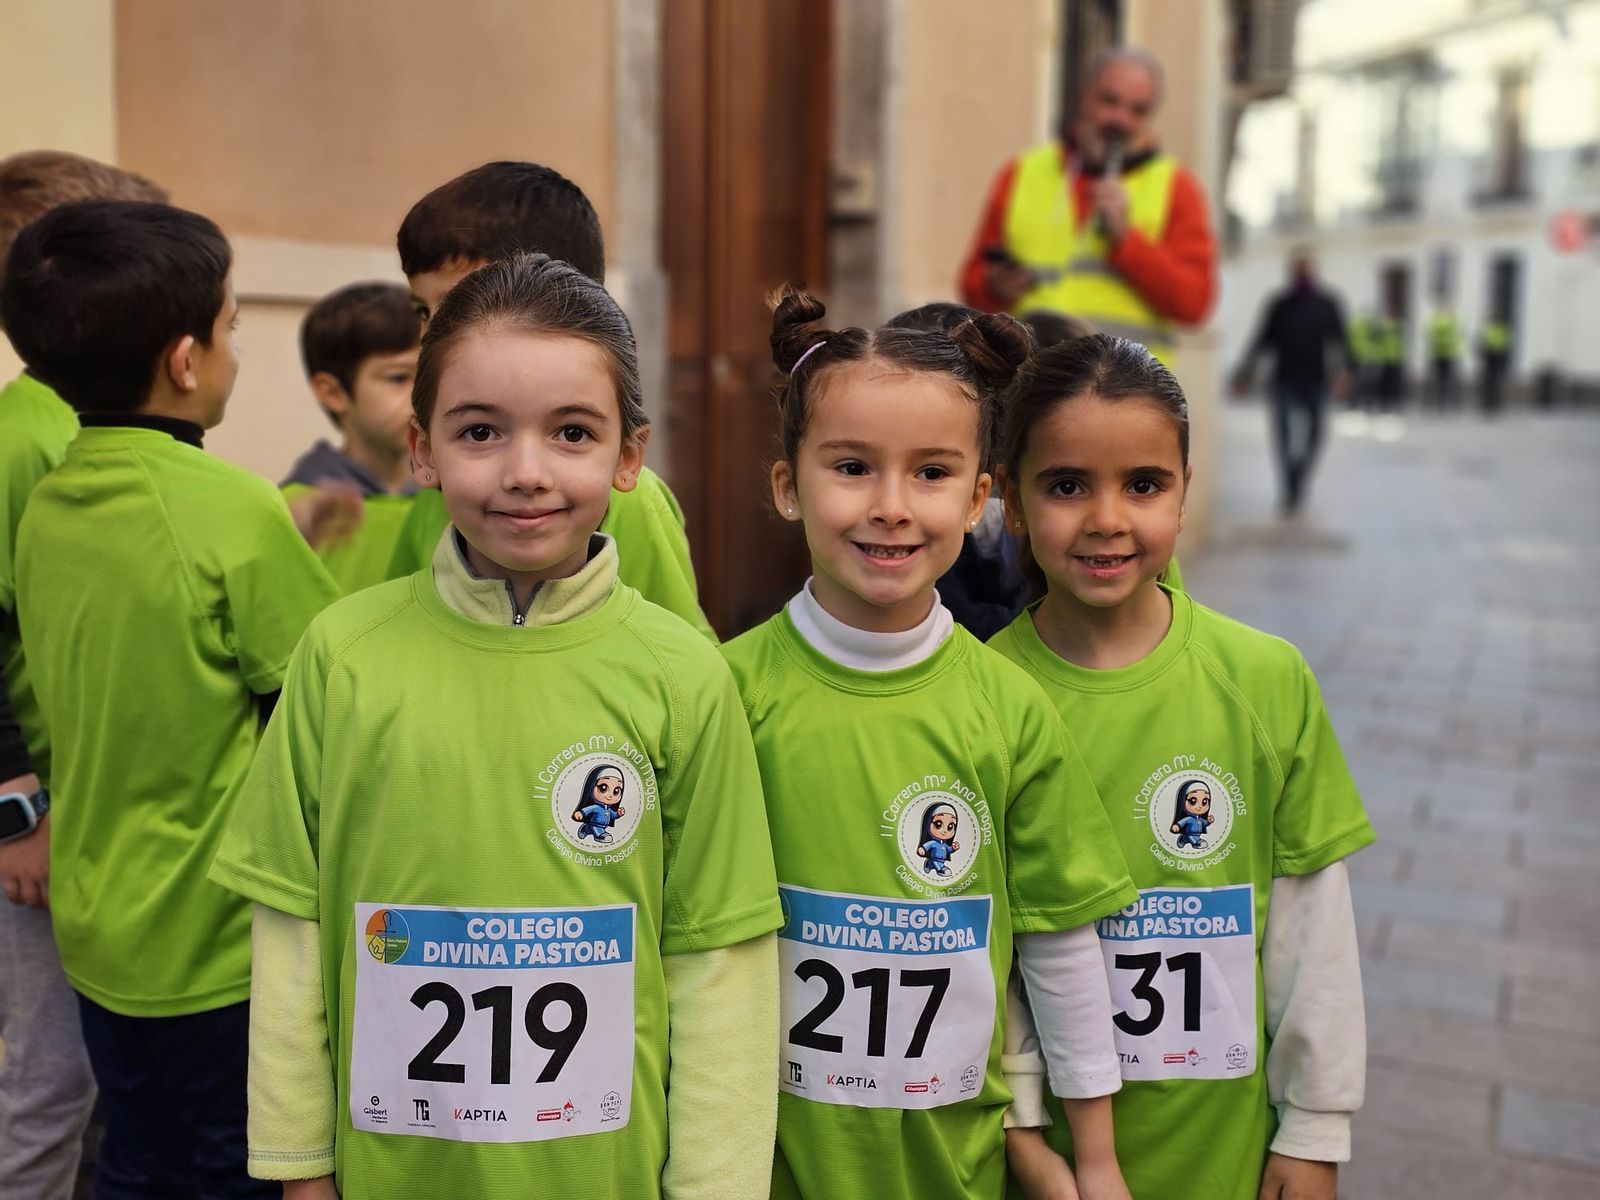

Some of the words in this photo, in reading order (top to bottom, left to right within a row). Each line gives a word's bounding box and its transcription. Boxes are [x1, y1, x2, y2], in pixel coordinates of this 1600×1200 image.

[538, 742, 585, 784] Carrera
[618, 742, 644, 765] Ana
[1200, 757, 1222, 775] Ana
[950, 779, 976, 802] Ana
[546, 828, 573, 858] Colegio
[845, 903, 949, 929] COLEGIO
[1110, 896, 1202, 917] OLEGIO
[466, 916, 584, 940] COLEGIO
[802, 920, 884, 950] DIVINA
[889, 926, 976, 952] PASTORA
[1096, 918, 1140, 938] INA
[1143, 915, 1239, 936] PASTORA
[423, 941, 509, 965] DIVINA
[514, 939, 621, 965] PASTORA
[788, 958, 951, 1059] 217
[407, 981, 588, 1085] 219
[1118, 1053, 1140, 1064] TIA
[826, 1074, 877, 1089] KAPTIA
[454, 1108, 508, 1122] KAPTIA
